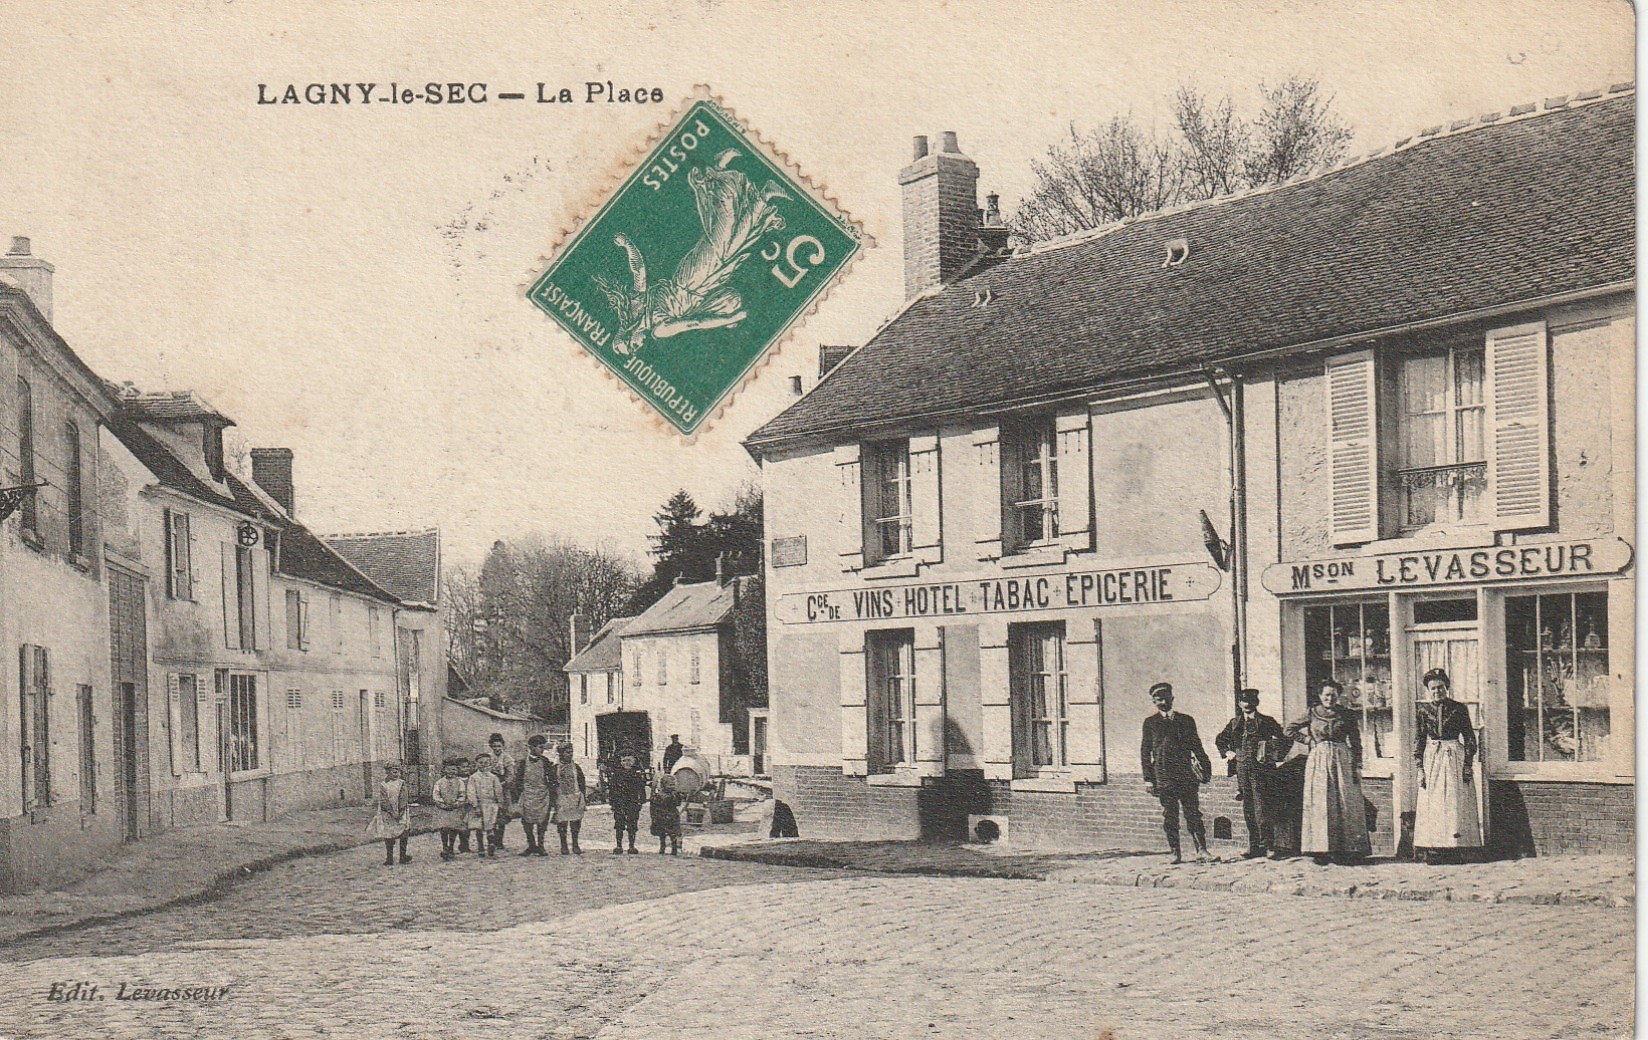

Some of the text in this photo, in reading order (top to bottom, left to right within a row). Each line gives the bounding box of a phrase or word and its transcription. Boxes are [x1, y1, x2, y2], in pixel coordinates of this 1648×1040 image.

[643, 119, 710, 190] POSTES
[541, 282, 611, 346] FRANÇAISE
[1376, 543, 1594, 585] LEVASSEUR
[853, 589, 893, 618] VINS
[904, 584, 966, 615] HOTEL
[980, 577, 1049, 611] TABAC
[1066, 568, 1173, 606] ÉPICERIE
